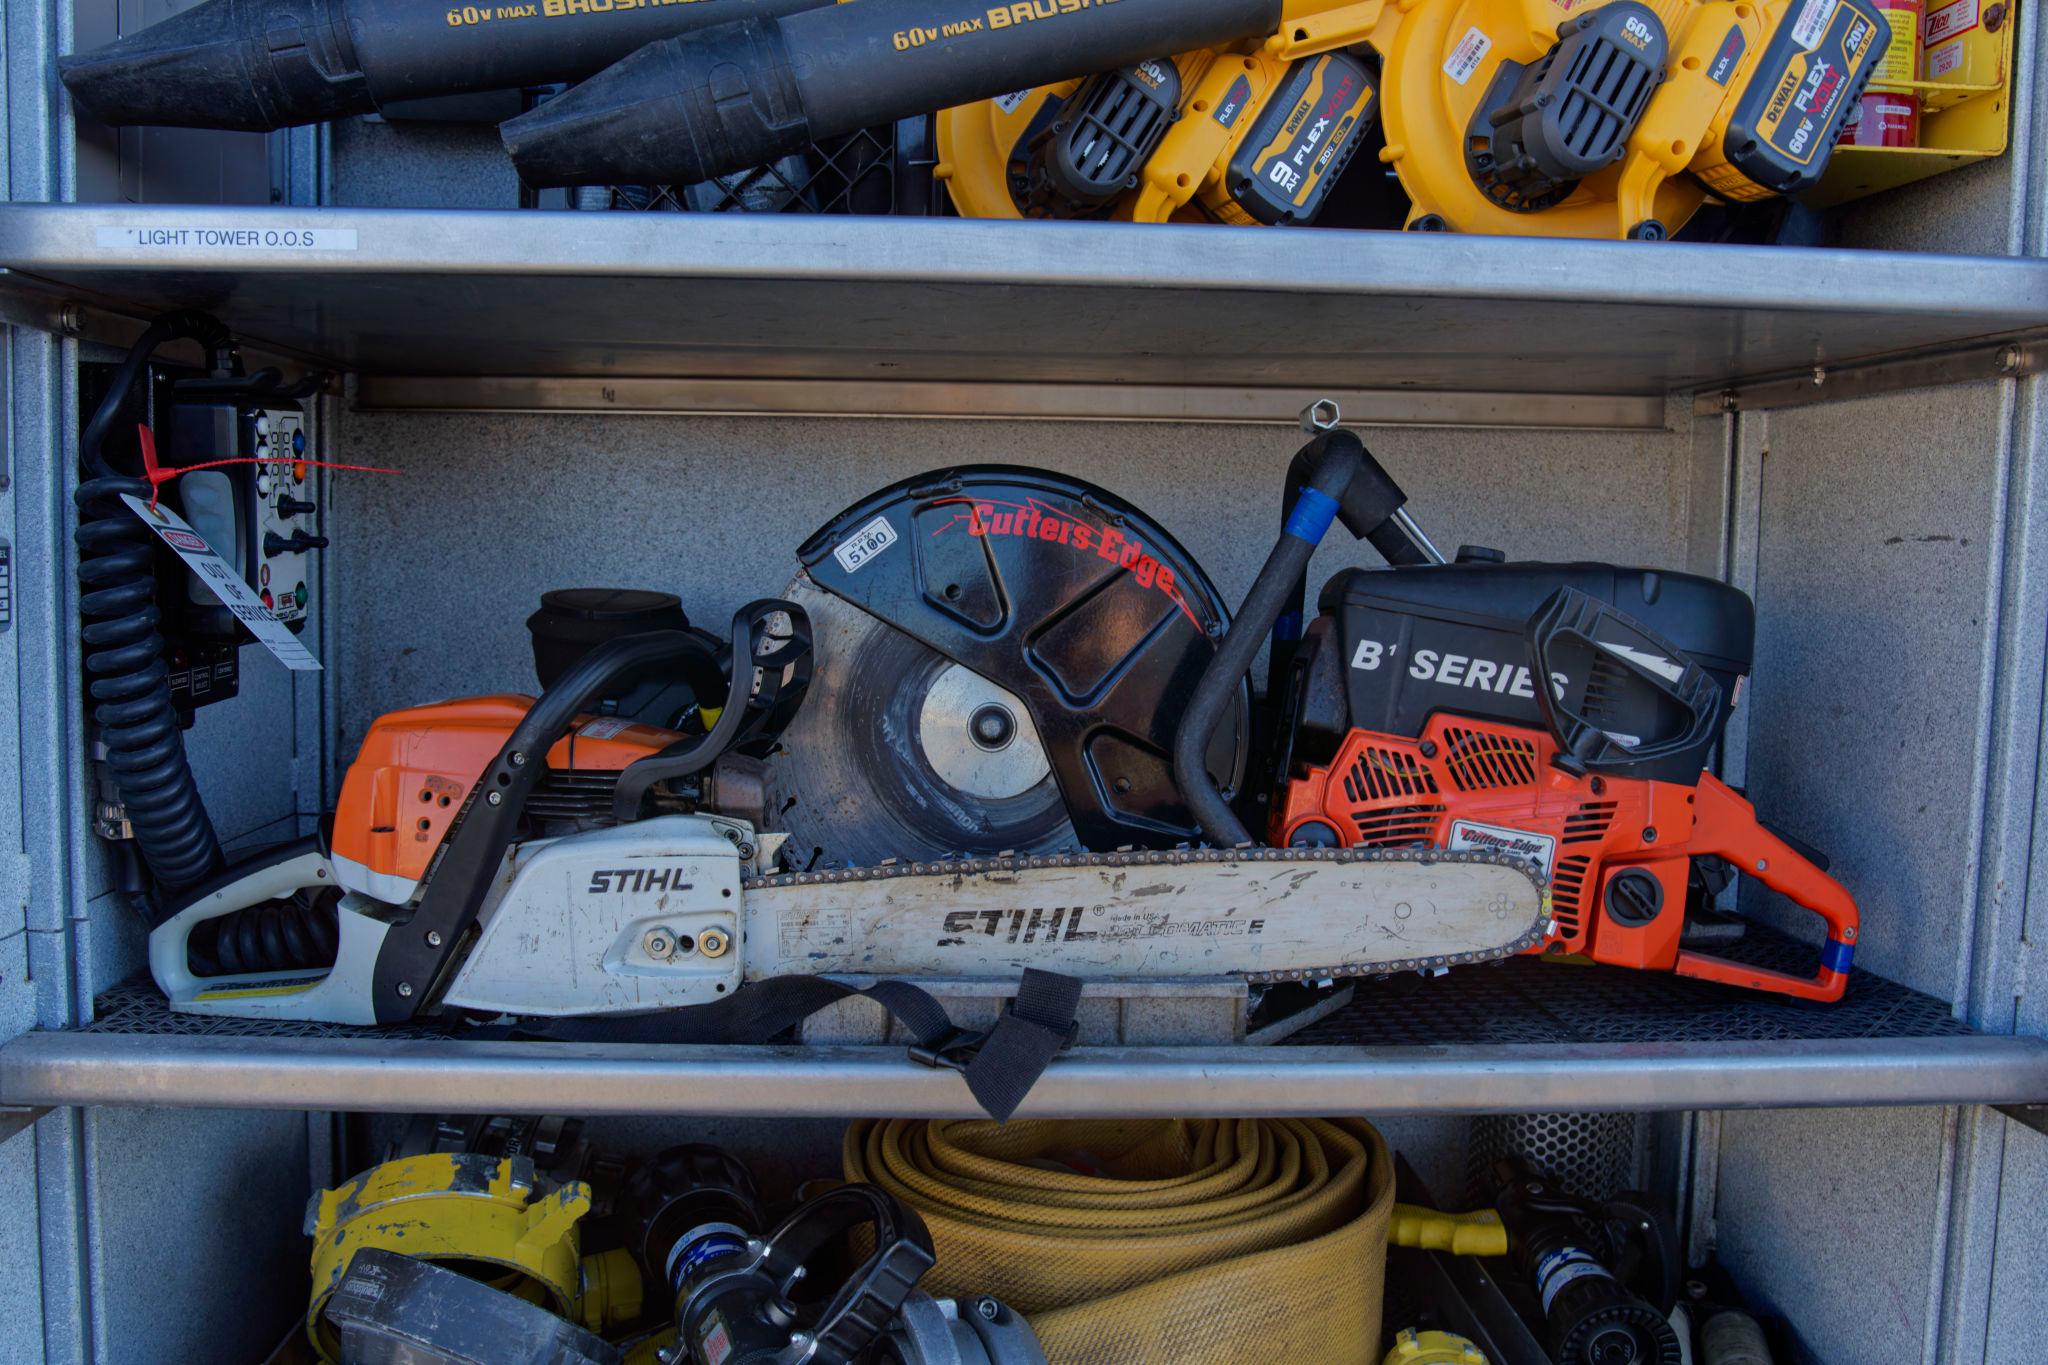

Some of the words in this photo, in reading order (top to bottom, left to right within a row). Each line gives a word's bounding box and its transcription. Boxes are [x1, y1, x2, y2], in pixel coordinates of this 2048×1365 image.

[496, 5, 538, 20] MAX
[942, 18, 984, 38] MAX
[1620, 29, 1648, 51] MAX
[1794, 56, 1831, 112] FLEX
[1805, 64, 1841, 116] VOLT
[1269, 160, 1293, 188] 9
[138, 230, 189, 245] LIGHT
[194, 230, 260, 246] TOWER
[265, 231, 314, 247] O.O.S
[848, 531, 887, 564] 5100
[967, 503, 1093, 550] Cutters
[1096, 525, 1176, 593] Edge
[200, 562, 231, 580] OUT
[224, 583, 246, 600] OF
[230, 604, 279, 622] SERVICE
[1409, 649, 1569, 701] SERIES
[588, 867, 694, 894] STIHL
[936, 906, 1099, 947] STIHL
